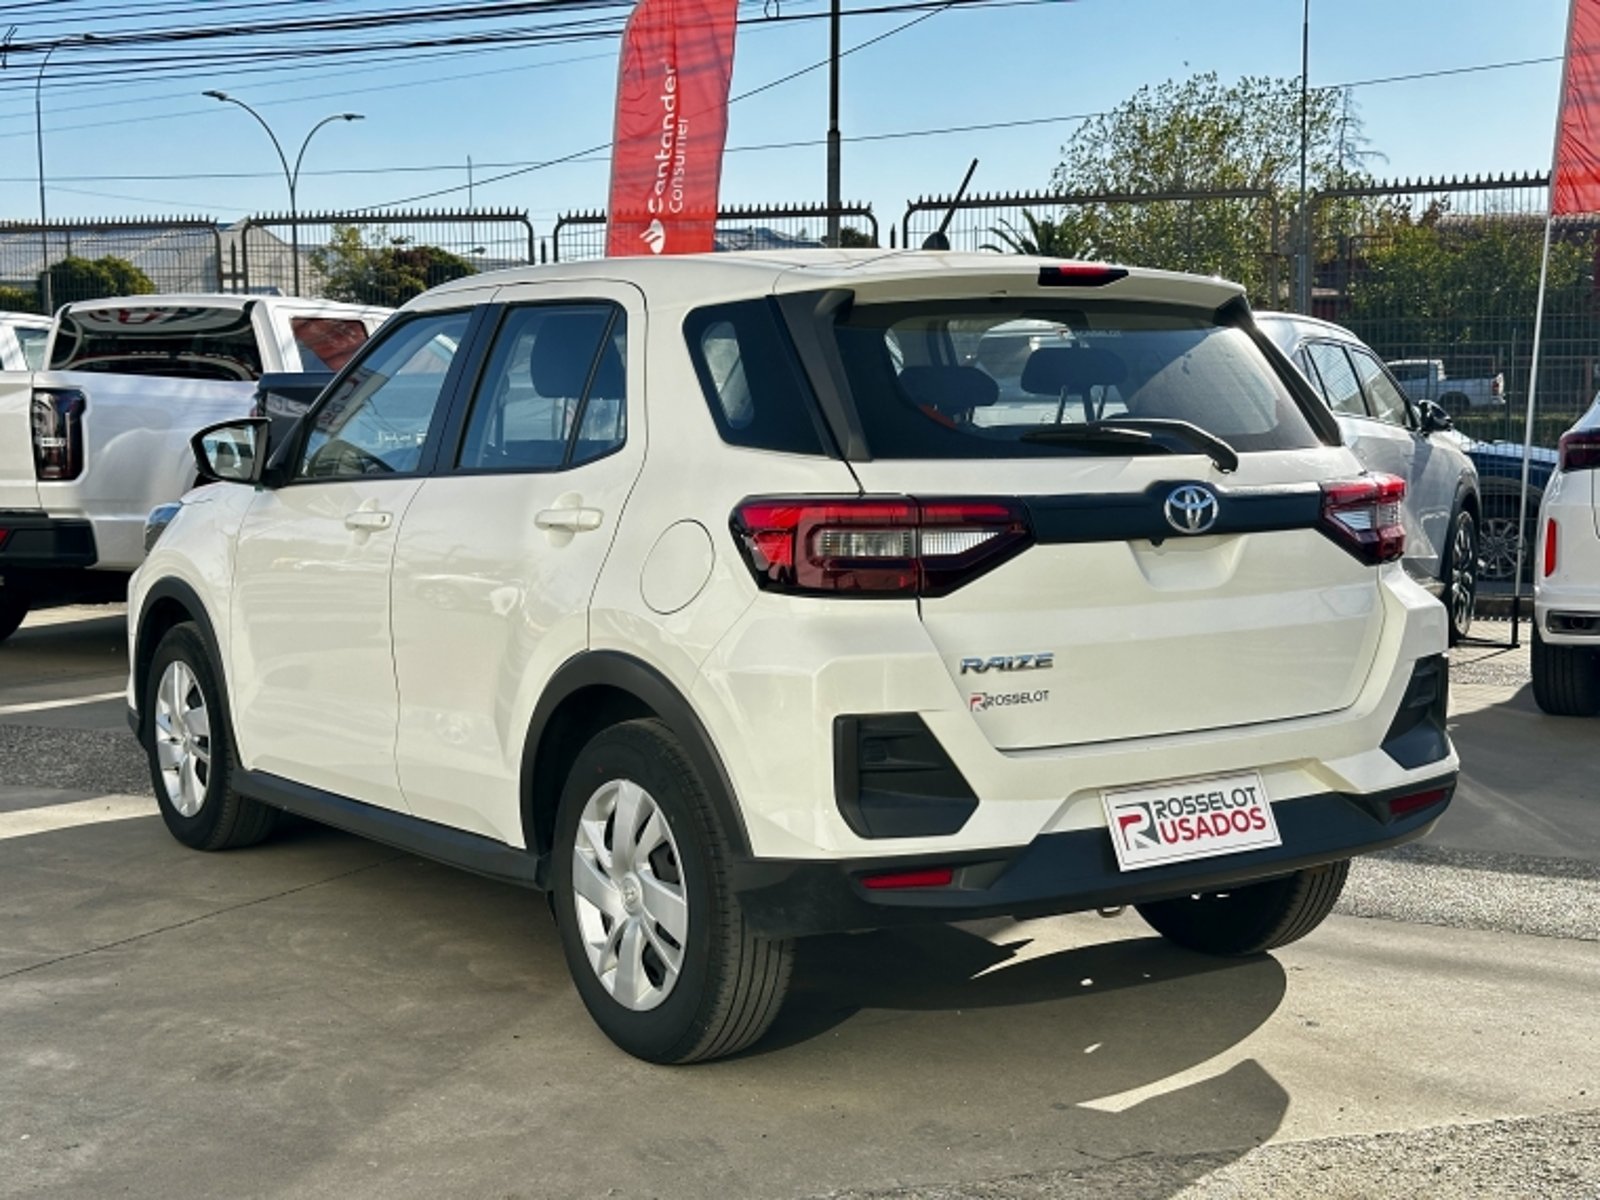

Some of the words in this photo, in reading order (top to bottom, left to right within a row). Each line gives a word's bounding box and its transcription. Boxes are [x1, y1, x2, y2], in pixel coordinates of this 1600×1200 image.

[648, 64, 678, 214] Santander
[961, 652, 1054, 674] RAIZE
[1153, 787, 1256, 819] ROSSELOT
[1160, 807, 1266, 844] USADOS
